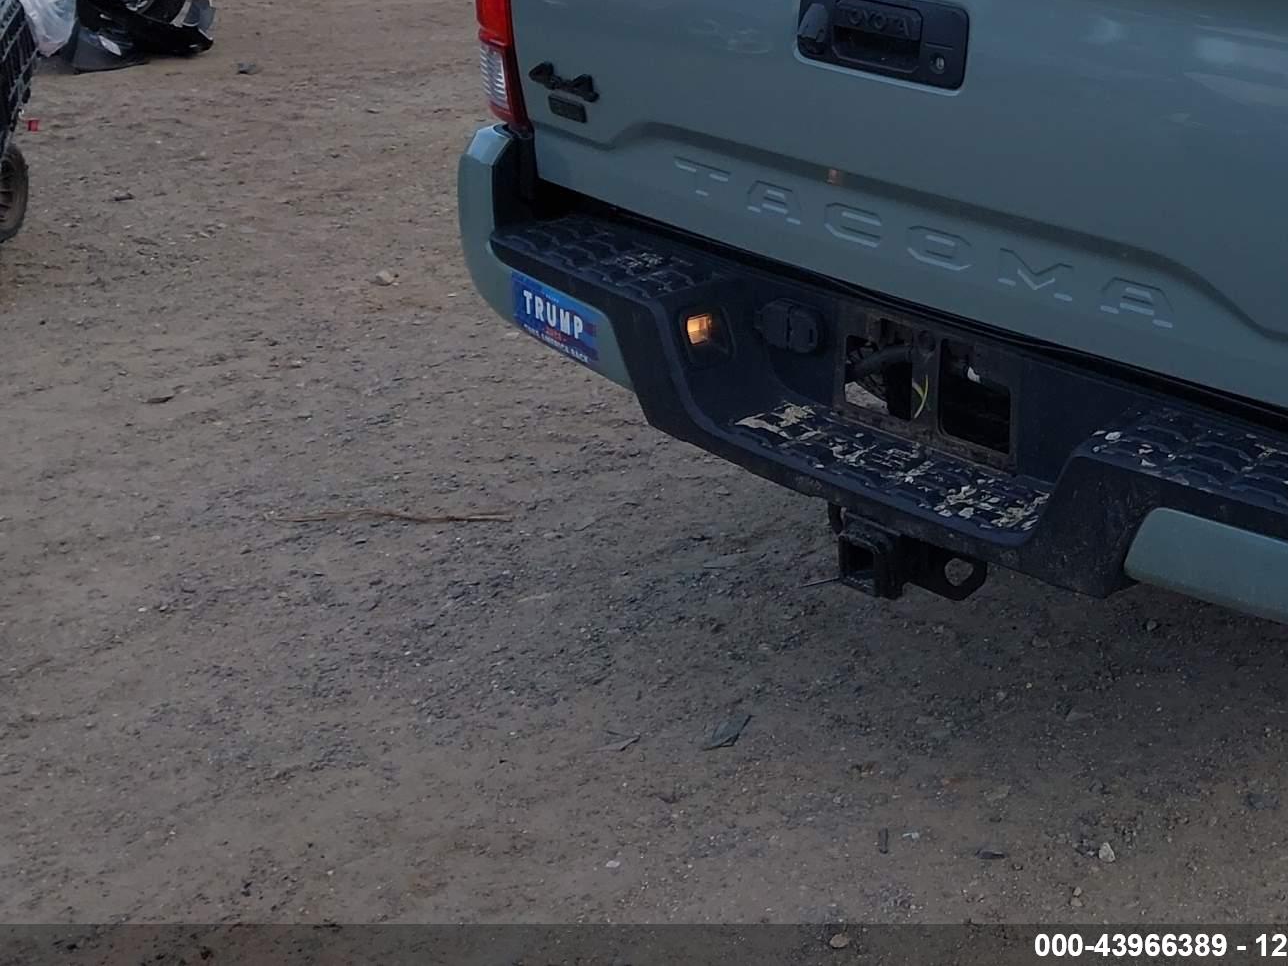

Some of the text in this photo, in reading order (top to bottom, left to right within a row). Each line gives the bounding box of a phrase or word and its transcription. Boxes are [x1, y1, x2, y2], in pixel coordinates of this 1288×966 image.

[840, 5, 914, 38] TOYOTA
[674, 156, 1174, 329] TACOMA
[523, 290, 583, 339] TRUMP
